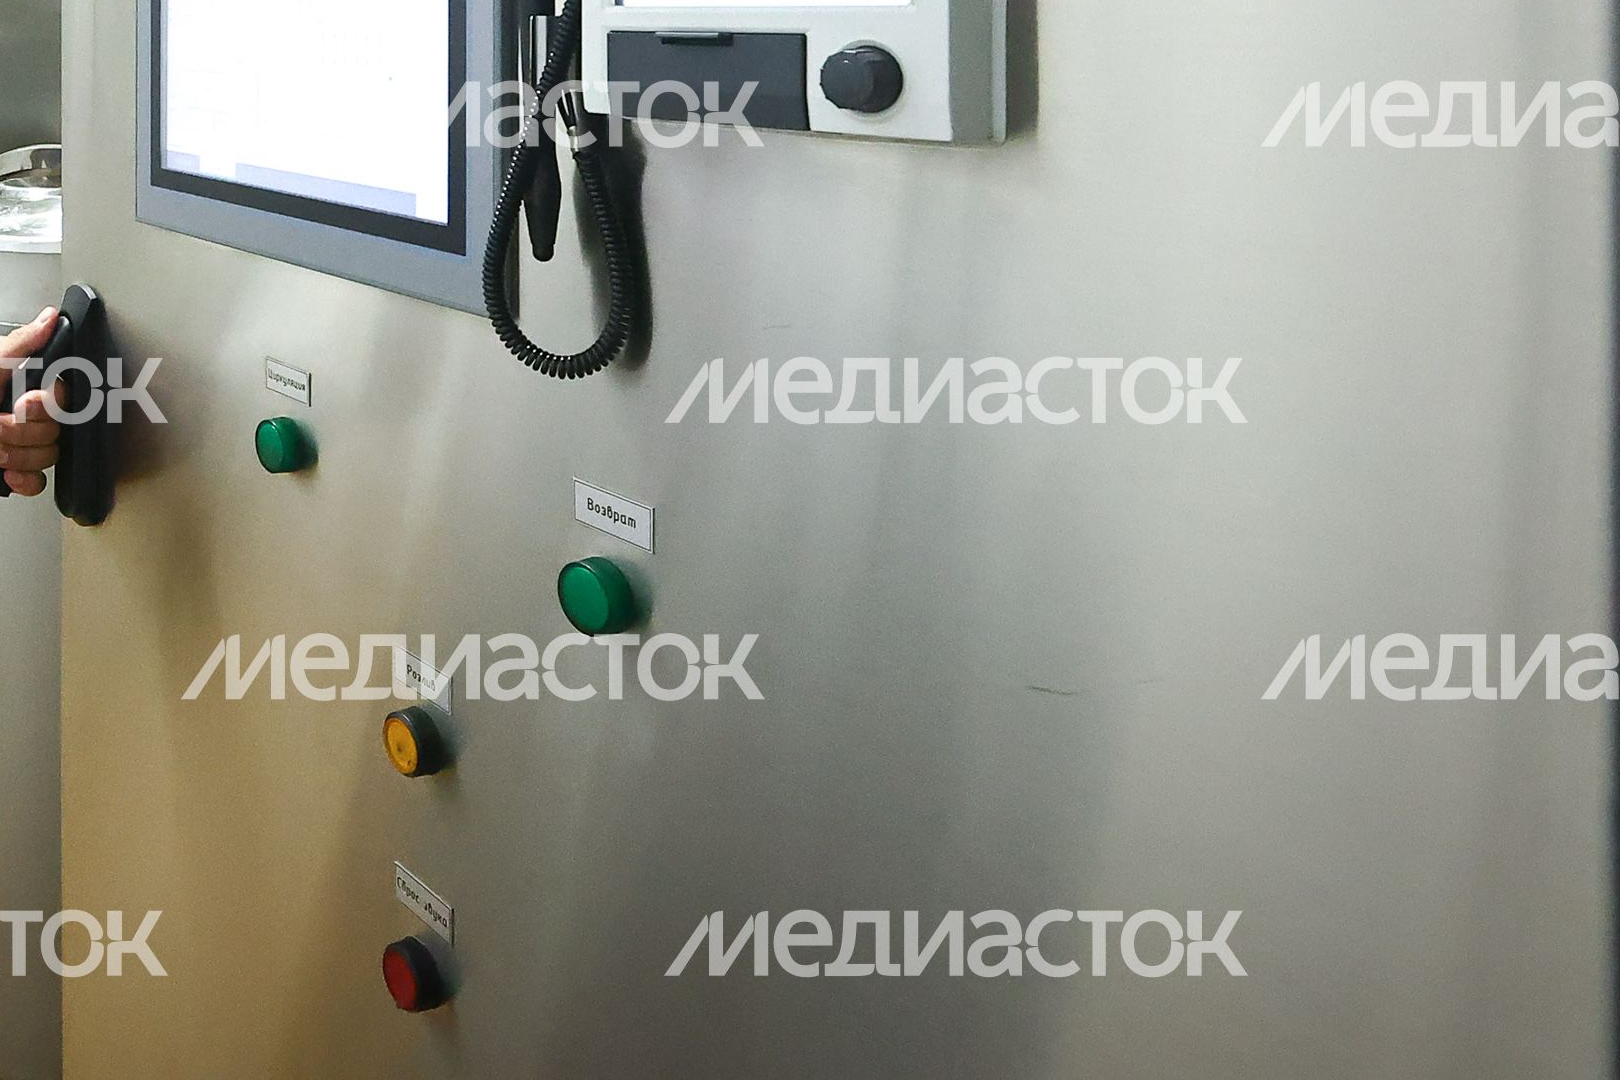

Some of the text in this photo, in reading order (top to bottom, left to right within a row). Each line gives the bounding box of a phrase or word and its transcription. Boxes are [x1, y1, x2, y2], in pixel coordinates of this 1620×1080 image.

[587, 497, 637, 529] Возврат
[406, 664, 436, 692] Розлив
[397, 876, 421, 904] Сброс
